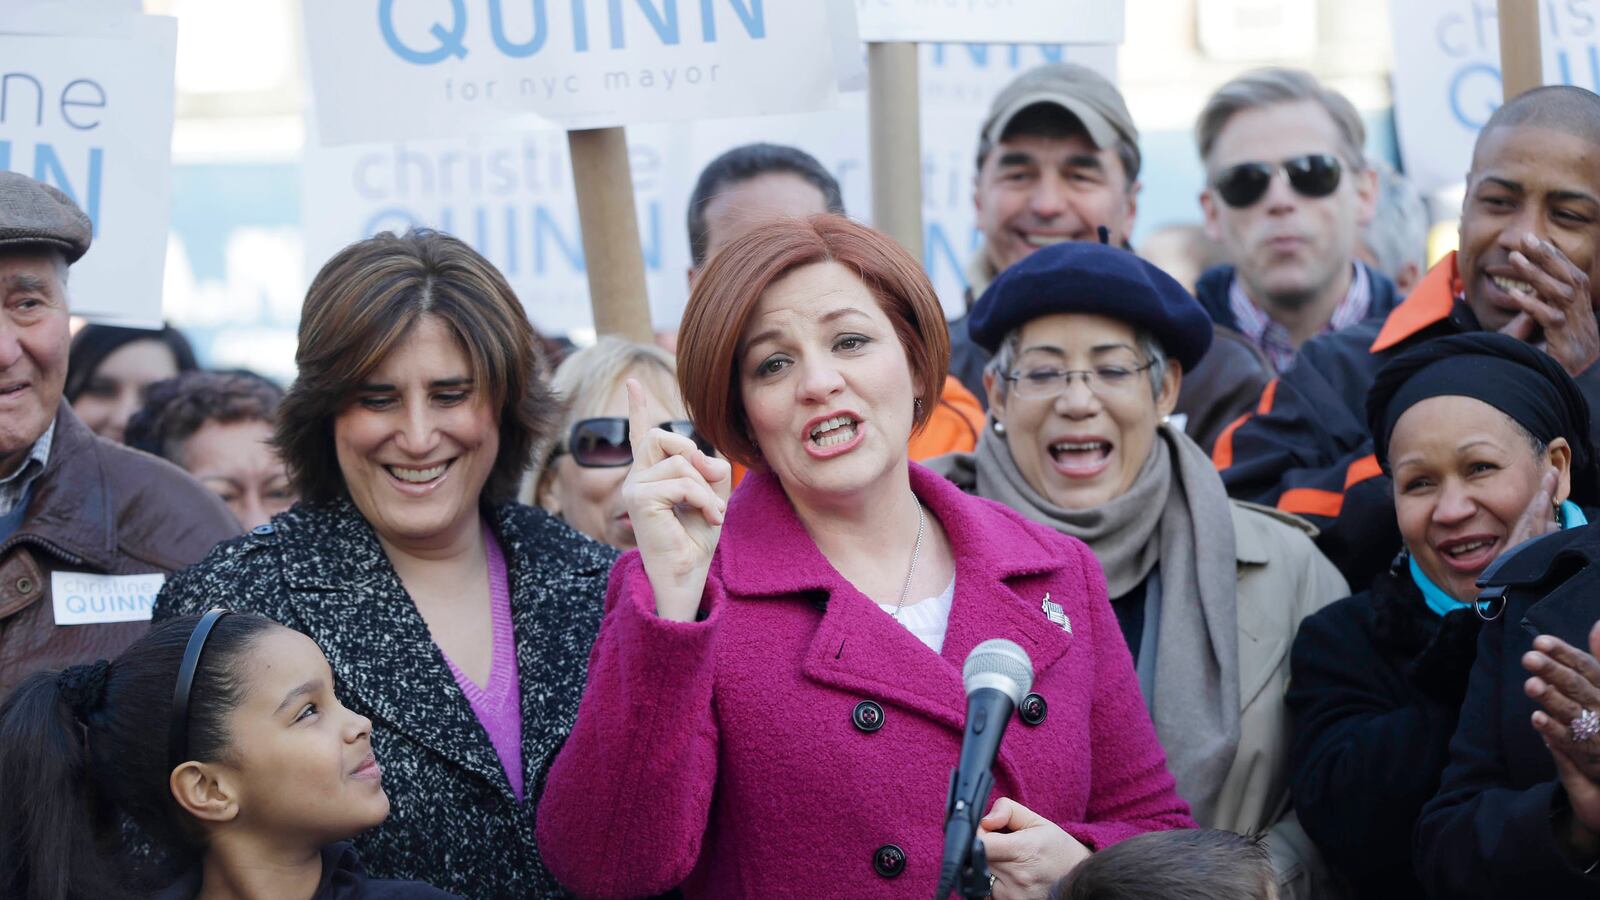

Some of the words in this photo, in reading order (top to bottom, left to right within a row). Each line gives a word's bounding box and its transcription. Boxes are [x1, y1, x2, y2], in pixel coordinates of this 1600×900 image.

[445, 77, 498, 102] for
[519, 74, 580, 99] nyc
[603, 63, 721, 92] mayor
[352, 130, 664, 201] christie
[63, 579, 153, 594] christine
[65, 594, 156, 614] QUINN
